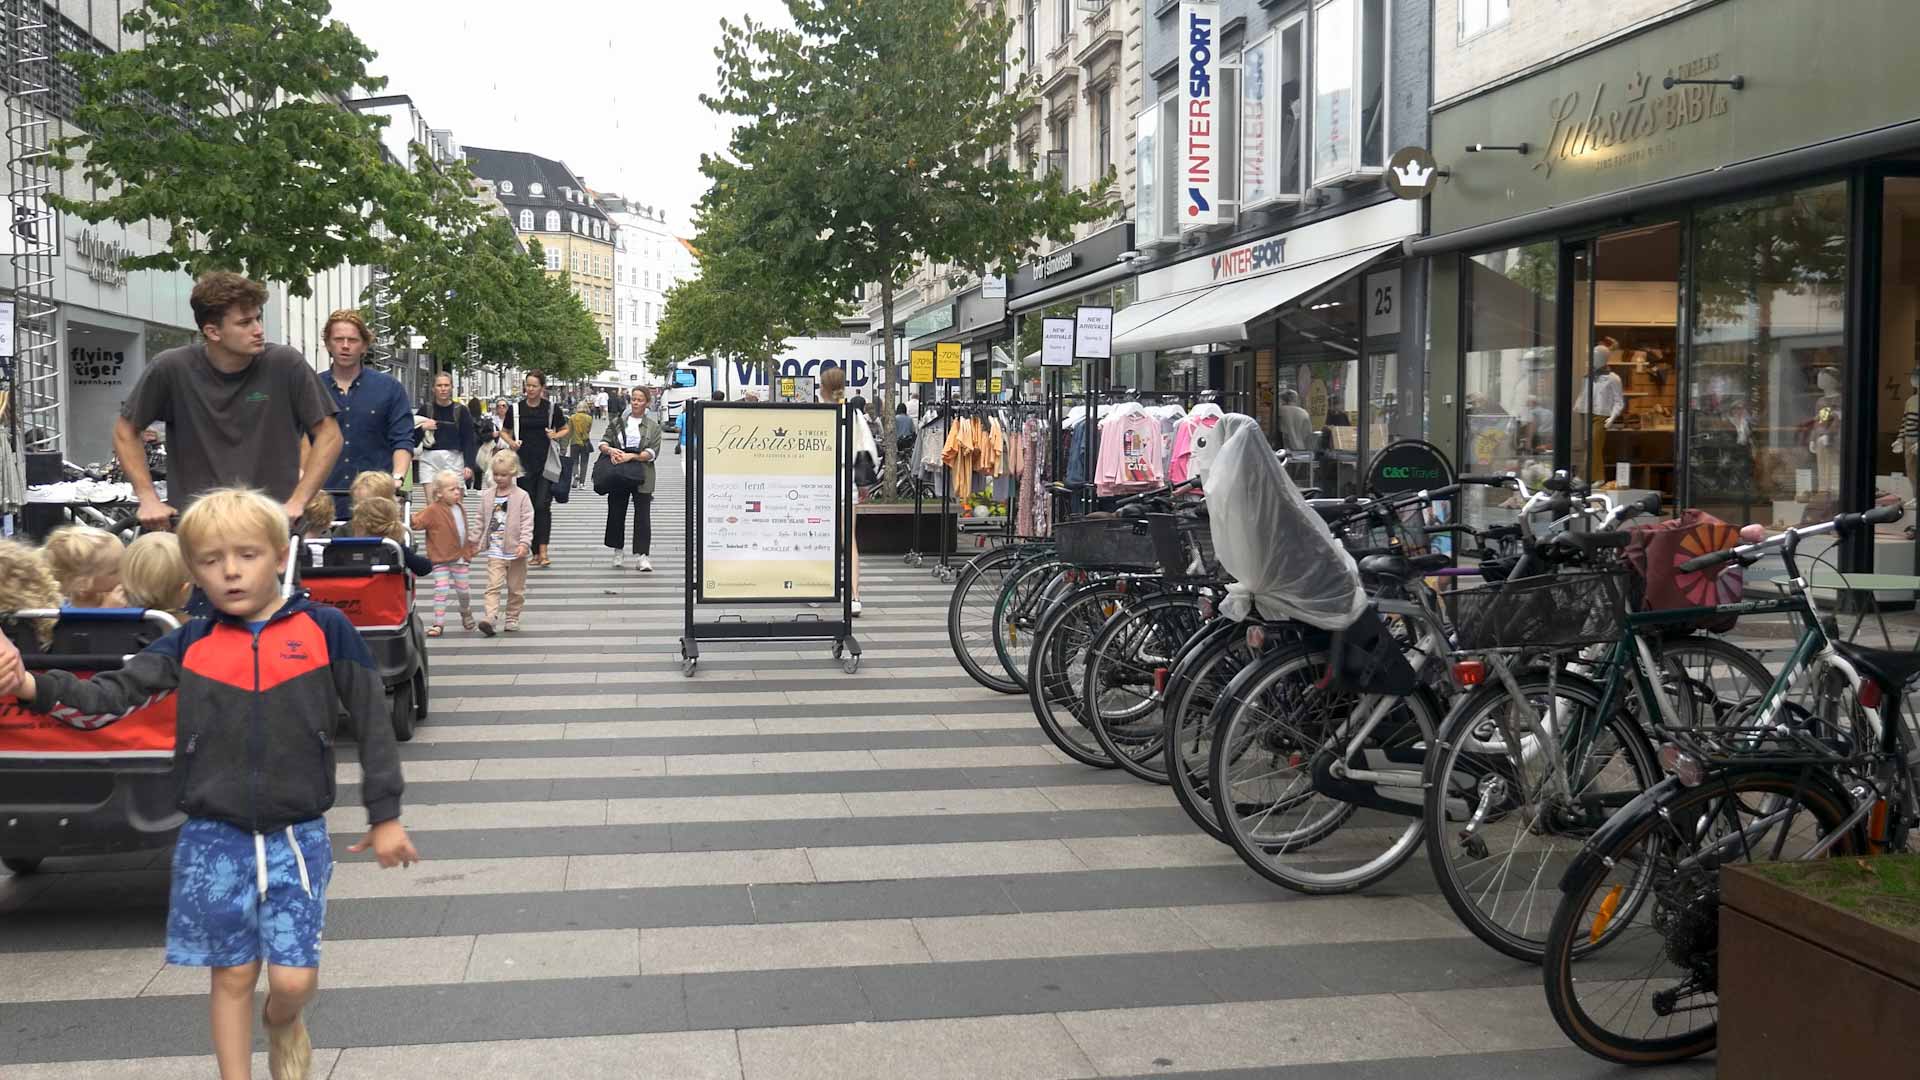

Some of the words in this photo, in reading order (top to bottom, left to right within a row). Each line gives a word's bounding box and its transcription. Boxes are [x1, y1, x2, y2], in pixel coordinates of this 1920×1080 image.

[1188, 13, 1211, 183] INTERSPORT
[1222, 237, 1288, 278] INTERSPORT
[1375, 286, 1392, 316] 25
[71, 347, 124, 364] flying
[73, 362, 121, 379] tiger
[798, 438, 826, 451] BABY
[1383, 467, 1409, 478] C&C
[1410, 466, 1439, 478] Travel
